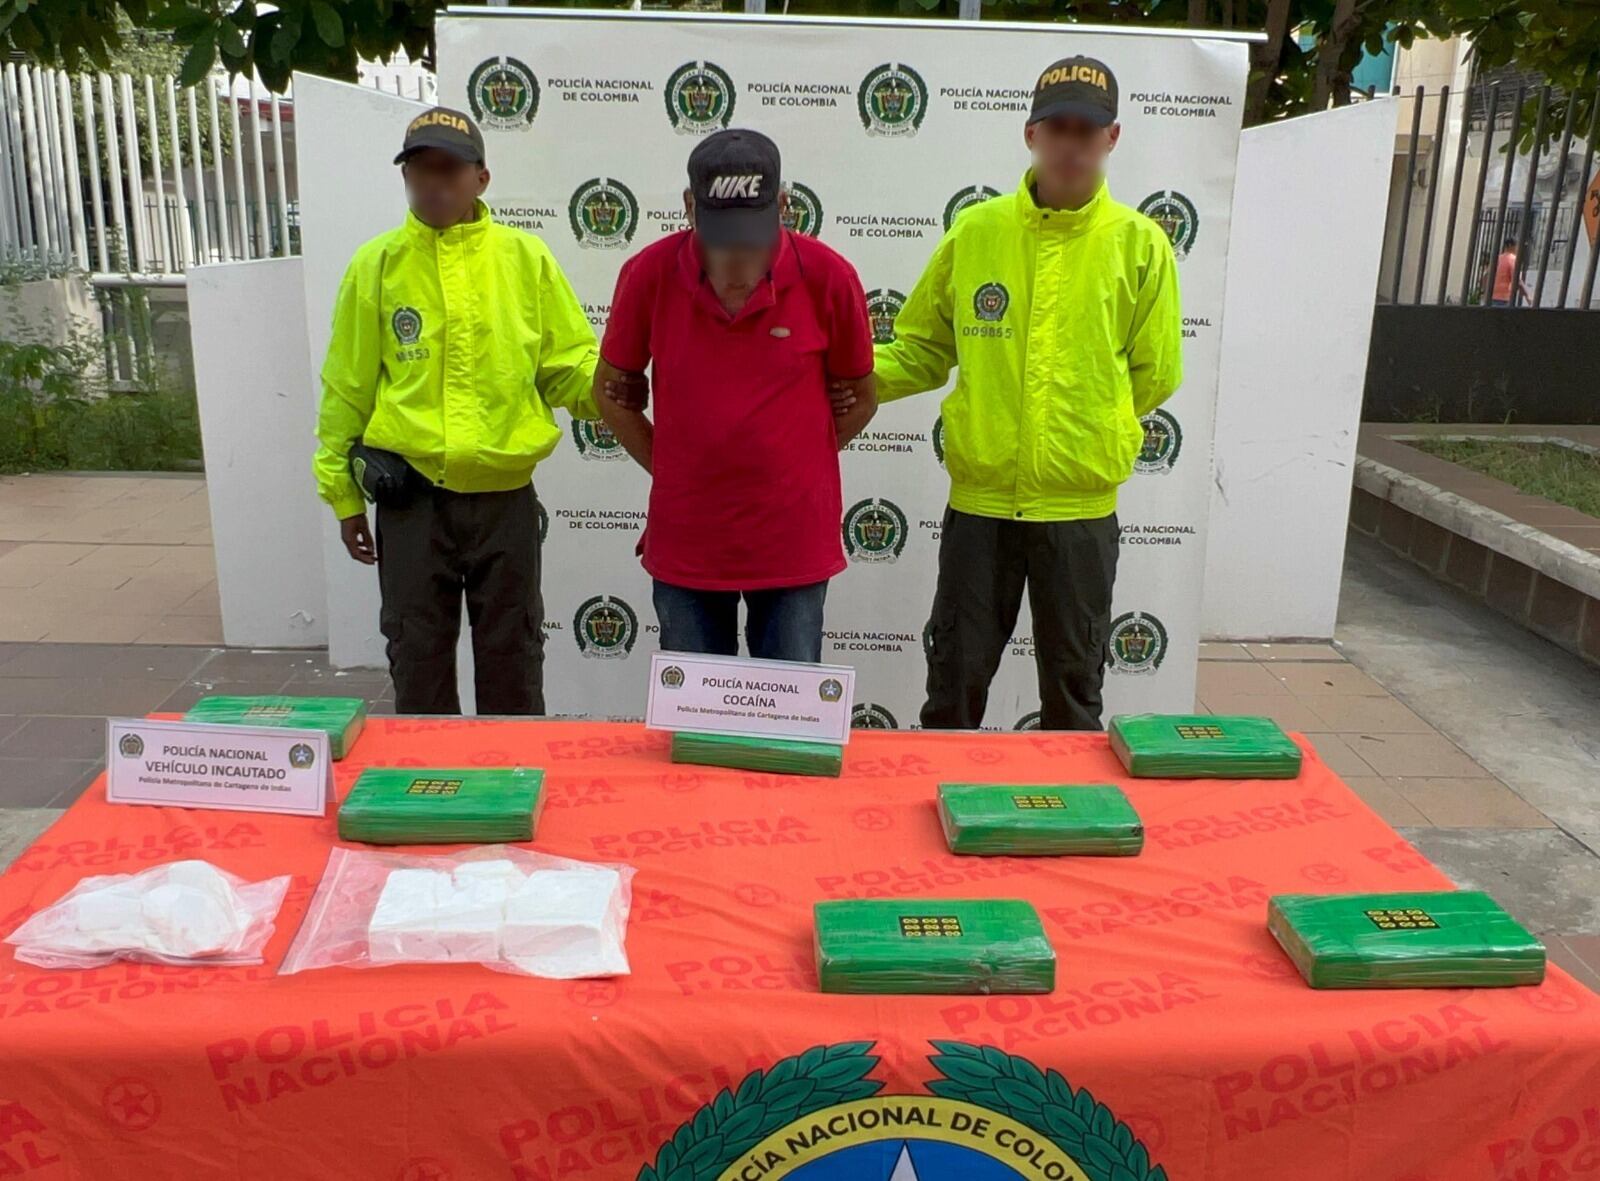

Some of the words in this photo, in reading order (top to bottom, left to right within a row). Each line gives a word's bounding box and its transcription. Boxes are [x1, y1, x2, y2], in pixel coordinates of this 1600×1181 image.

[548, 78, 592, 89] POLICÍA
[595, 80, 654, 90] NACIONAL
[1040, 65, 1108, 91] POLICIA
[747, 82, 790, 93] POLICÍA
[794, 84, 852, 94] NACIONAL
[940, 86, 983, 98] POLICÍA
[986, 89, 1035, 99] NACIONA
[562, 92, 577, 101] DE
[580, 92, 639, 102] COLOMBIA
[762, 97, 776, 106] DE
[779, 97, 837, 107] COLOMBIA
[1130, 91, 1171, 103] POLICÍA
[1174, 95, 1232, 105] NACIONAL
[953, 101, 968, 110] DE
[971, 101, 1028, 111] COLOMBIA
[1143, 106, 1157, 115] DE
[1160, 107, 1216, 117] COLOMBIA
[708, 175, 763, 199] NIKE
[500, 208, 558, 218] NACIONAL
[836, 214, 878, 225] POLICÍA
[881, 216, 938, 226] NACIONAL
[661, 223, 675, 232] DE
[850, 228, 864, 237] DE
[866, 228, 923, 238] COLOMBIA
[872, 432, 928, 442] NACIONAL
[858, 443, 913, 453] COLOMBIA
[556, 508, 597, 519] POLICÍA
[599, 510, 648, 520] NACIONA
[569, 521, 583, 529] DE
[585, 521, 640, 531] COLOMBIA
[1143, 525, 1196, 535] NACIONAL
[1129, 537, 1182, 546] COLOMBIA
[863, 632, 917, 642] NACIONAL
[833, 642, 847, 651] DE
[849, 642, 903, 653] COLOMBIA
[1012, 647, 1026, 656] DE
[702, 677, 743, 689] POLICÍA
[745, 681, 800, 694] NACIONAL
[723, 694, 777, 709] COCAÍNA
[757, 711, 790, 721] Cartagena
[800, 715, 820, 723] Indias
[163, 744, 206, 758] POLICÍA
[209, 748, 268, 762] NACIONAL
[145, 760, 208, 775] VEHÍCULO
[212, 765, 286, 780] INCAUTADO
[1145, 798, 1335, 839] POLICIA
[590, 816, 812, 848] POLICIA
[1156, 809, 1352, 851] NACIONAL
[24, 822, 264, 855] POLICIA
[596, 830, 822, 859] NACIONAL
[11, 836, 267, 873] NACIONAL
[940, 971, 1199, 1036] POLICIA
[205, 991, 510, 1082] POLICIA
[218, 1013, 518, 1113] NACIONAL
[1213, 1003, 1488, 1112] POLICIA
[1223, 1026, 1511, 1141] NACIONAL
[785, 1107, 943, 1154] NACIONAL
[949, 1113, 992, 1138] DE
